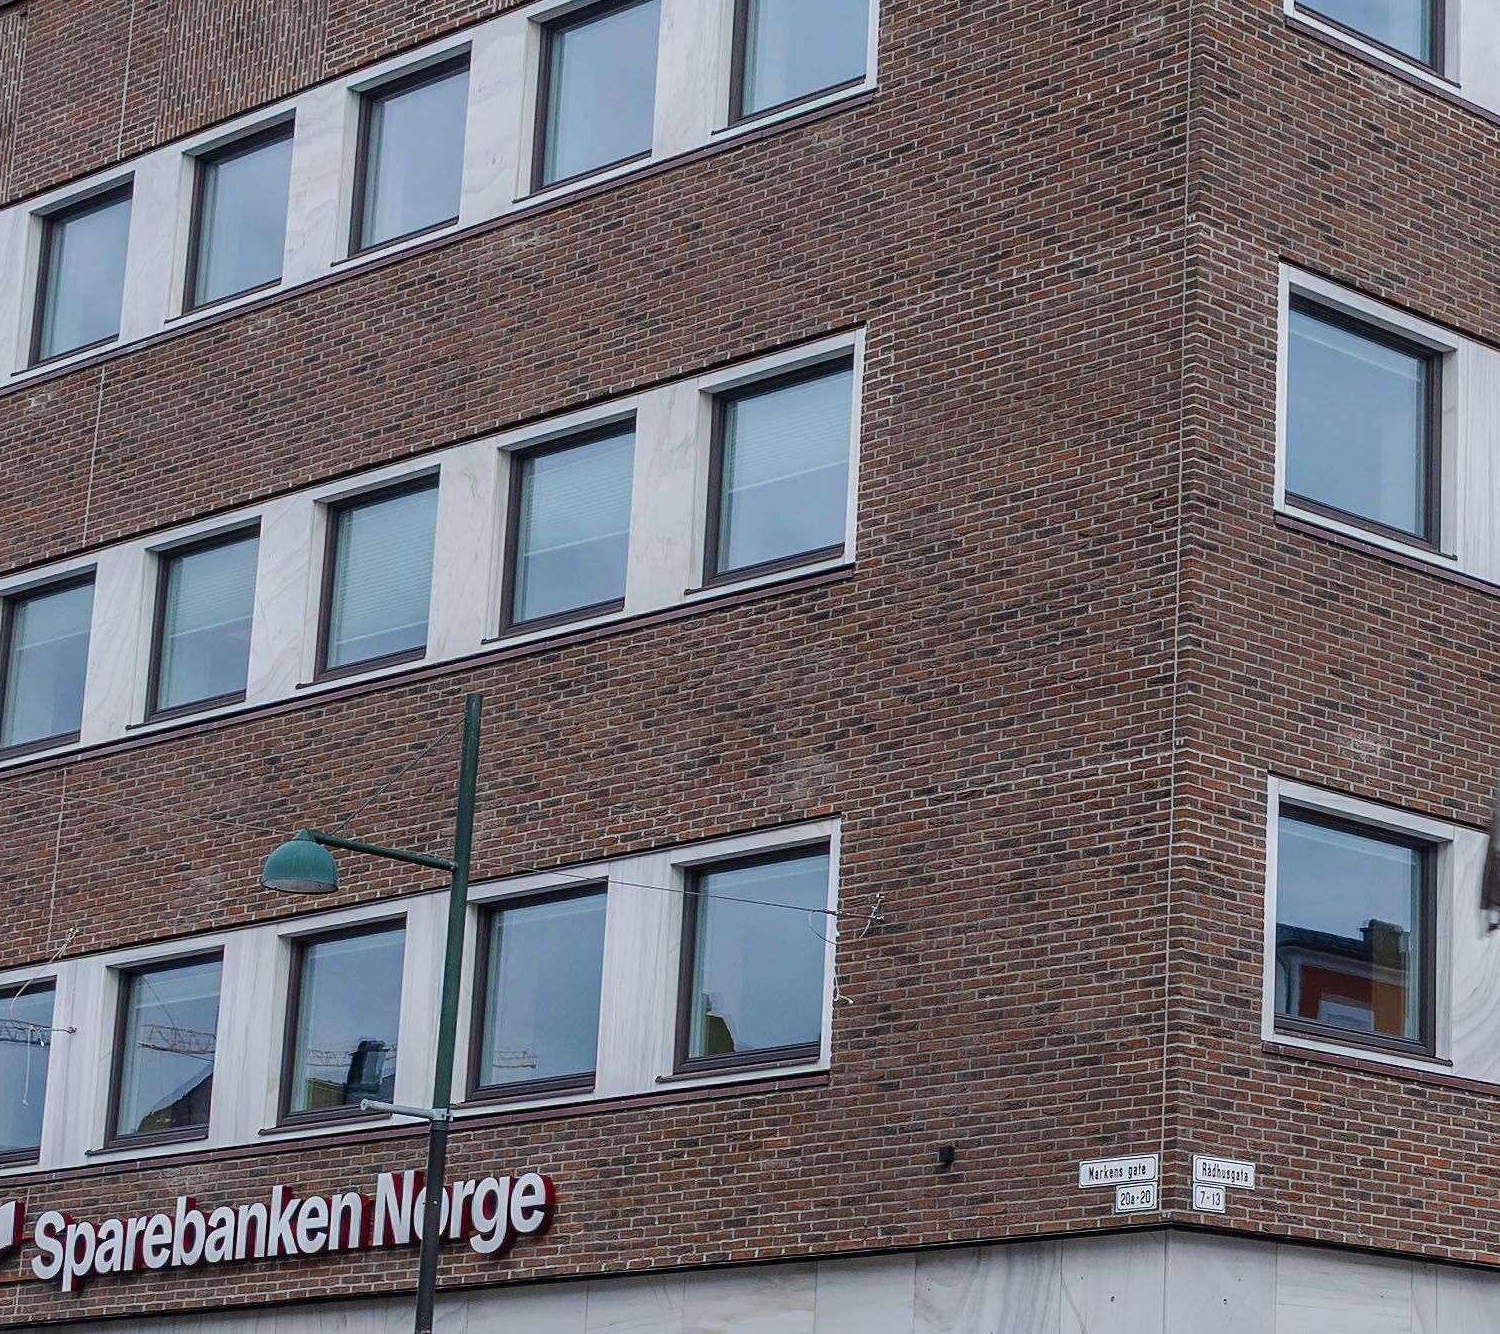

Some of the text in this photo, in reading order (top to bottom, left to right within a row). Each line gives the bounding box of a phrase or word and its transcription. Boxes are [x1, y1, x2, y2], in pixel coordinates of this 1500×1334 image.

[1088, 1162, 1147, 1181] Markens gate
[1202, 1161, 1249, 1183] Rådhusgata
[1120, 1189, 1151, 1206] 20a-20
[31, 1169, 548, 1292] Sparebanken Norge
